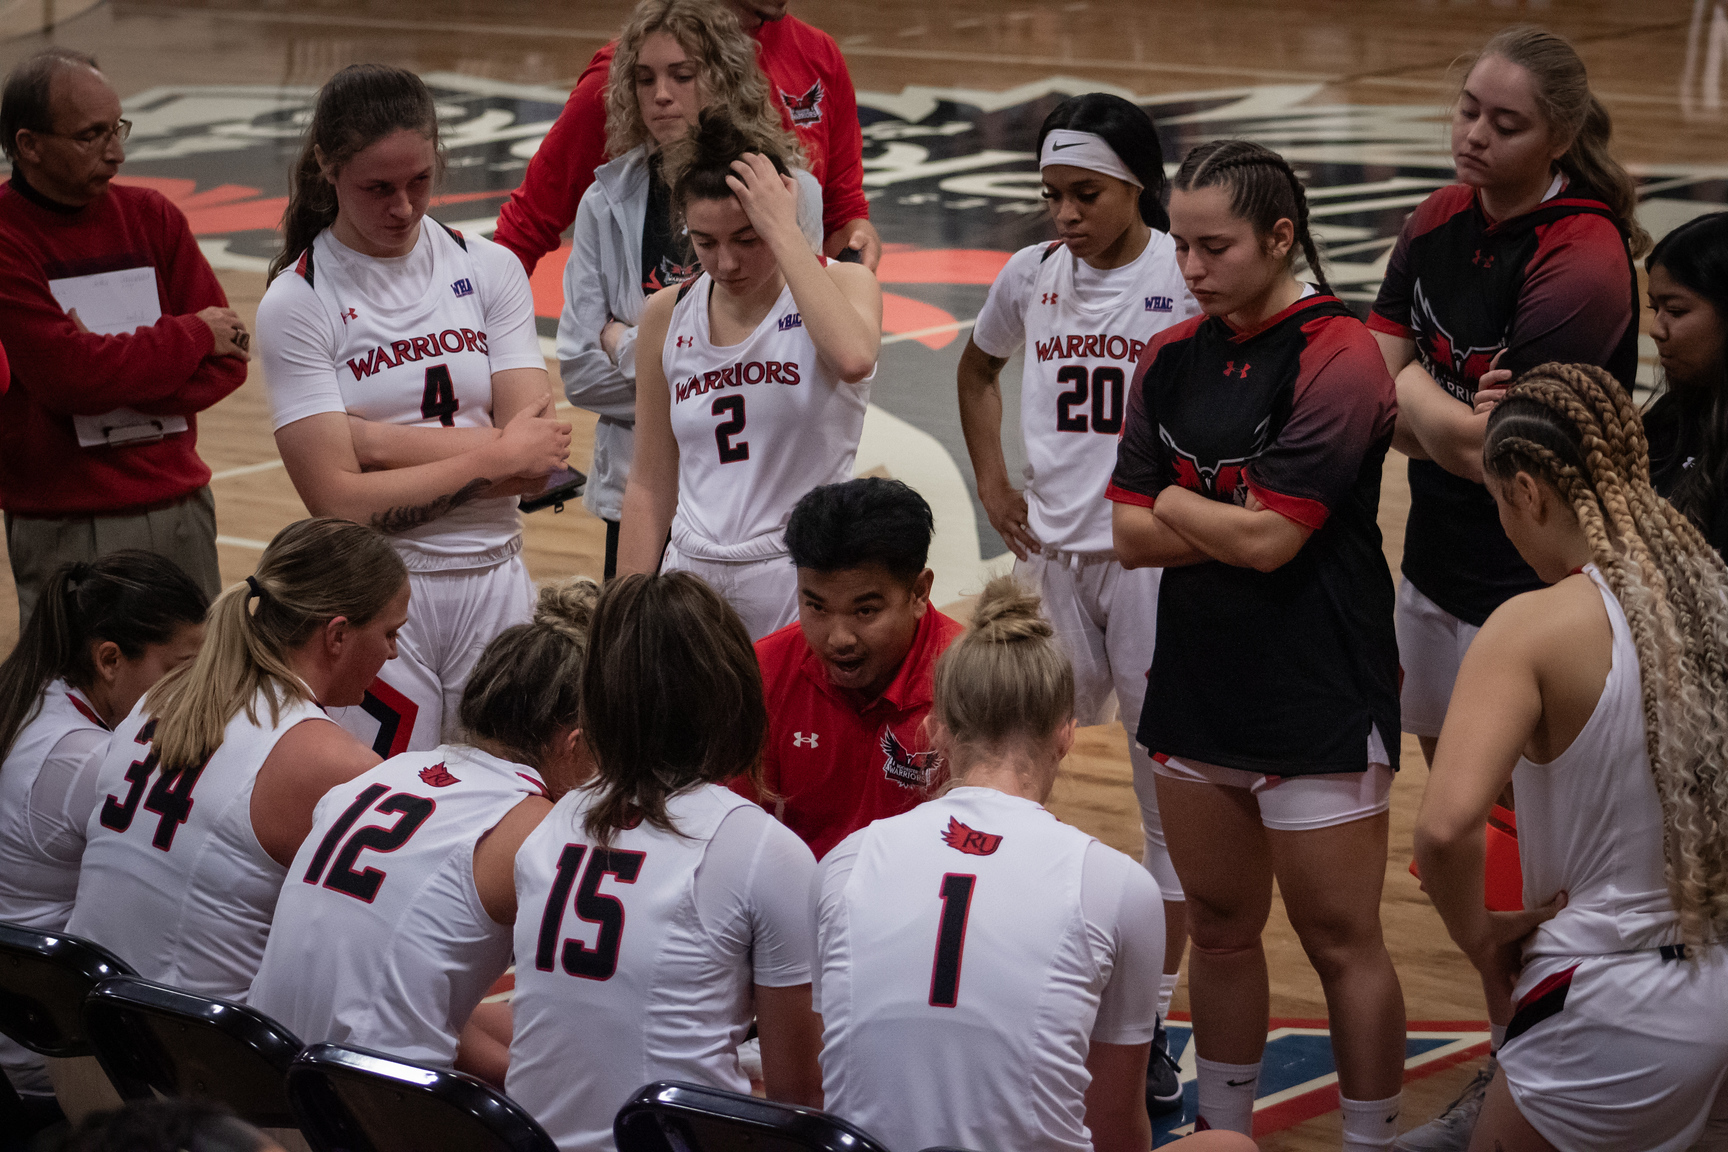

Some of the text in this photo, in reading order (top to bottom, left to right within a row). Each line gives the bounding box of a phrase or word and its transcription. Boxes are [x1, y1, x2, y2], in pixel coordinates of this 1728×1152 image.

[1144, 296, 1173, 310] WHAC
[346, 328, 488, 381] WARRIORS
[1035, 334, 1147, 363] WARRIOR
[420, 363, 459, 428] 4
[675, 361, 801, 405] WARRIORS
[1056, 365, 1125, 435] 20
[711, 393, 750, 465] 2
[100, 718, 217, 852] 34
[303, 782, 436, 904] 12
[962, 832, 1000, 853] RU
[535, 842, 647, 982] 15
[928, 872, 977, 1008] 1
